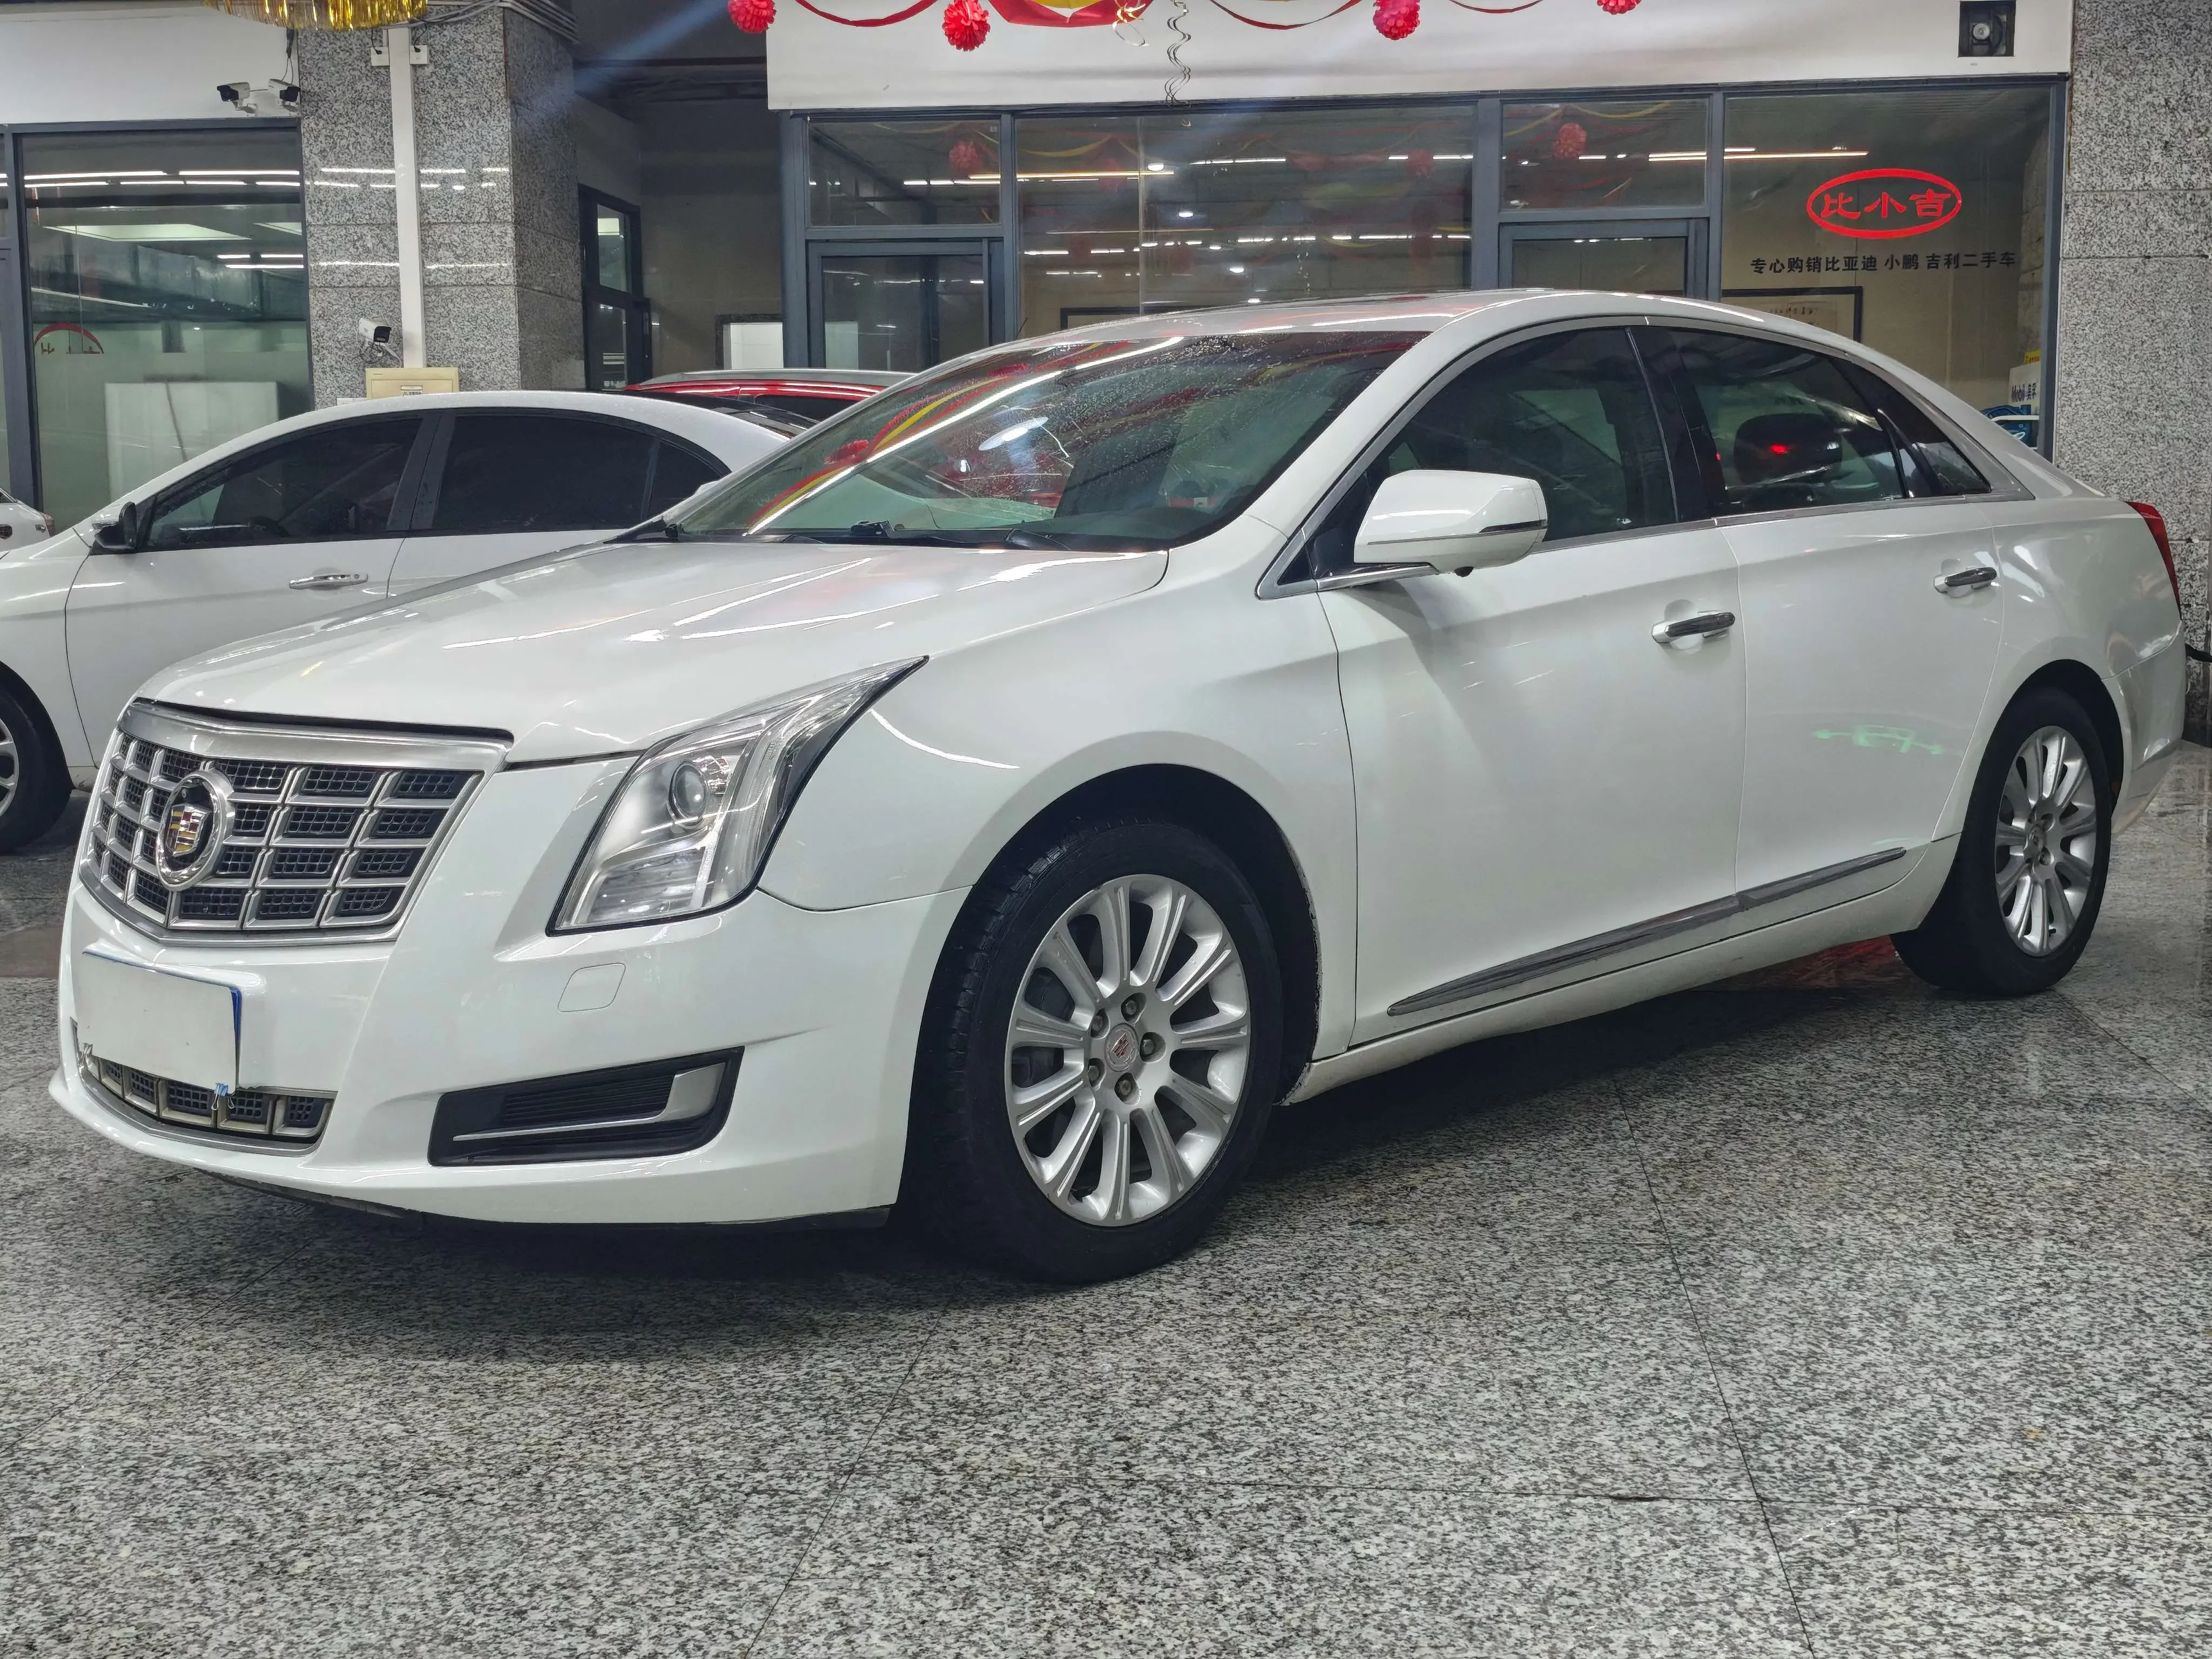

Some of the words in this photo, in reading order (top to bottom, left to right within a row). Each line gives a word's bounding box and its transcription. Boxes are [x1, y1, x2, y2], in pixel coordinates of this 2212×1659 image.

[1820, 188, 1952, 219] 比小吉
[1750, 255, 1878, 274] 专心购销比亚迪
[1884, 253, 1919, 271] 小鹏
[1926, 251, 2016, 269] 吉利二手车
